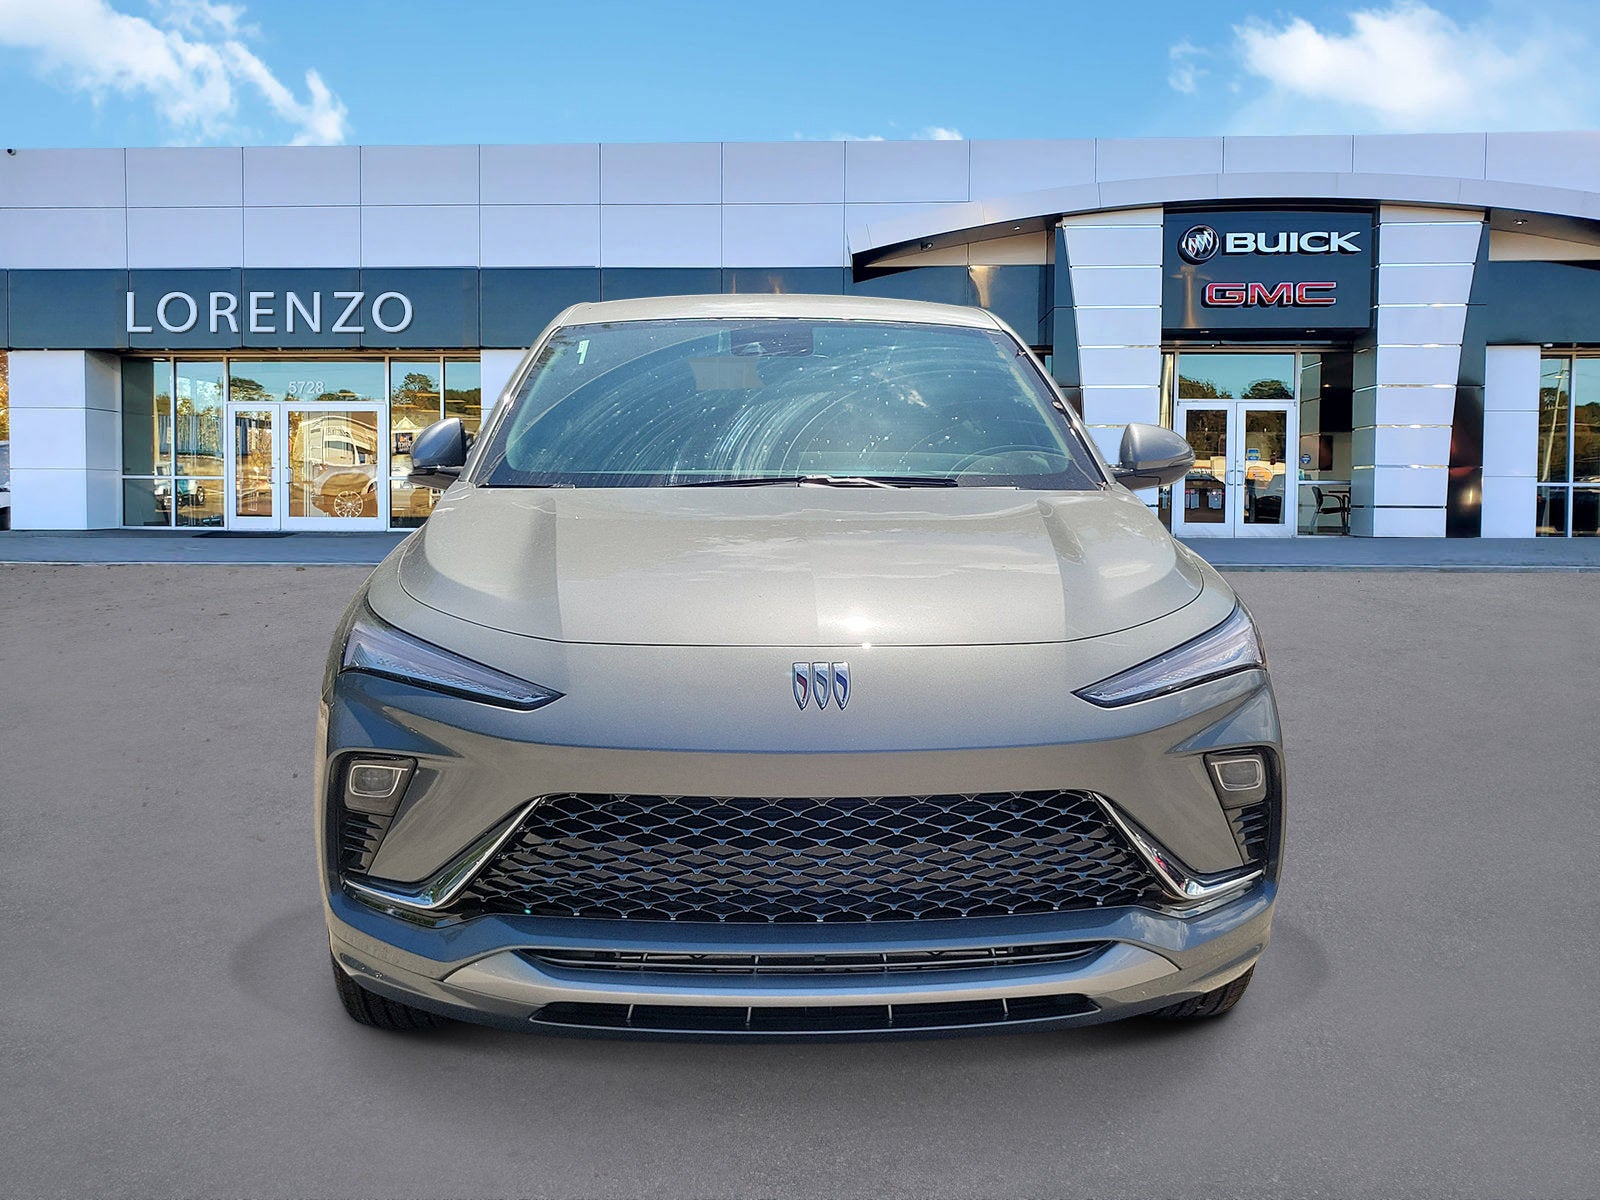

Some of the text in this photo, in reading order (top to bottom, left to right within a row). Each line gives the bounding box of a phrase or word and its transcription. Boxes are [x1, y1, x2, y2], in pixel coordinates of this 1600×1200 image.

[1225, 231, 1362, 253] BUICK
[1205, 281, 1337, 306] GMC
[125, 290, 414, 334] LORENZO
[288, 380, 325, 395] 5728
